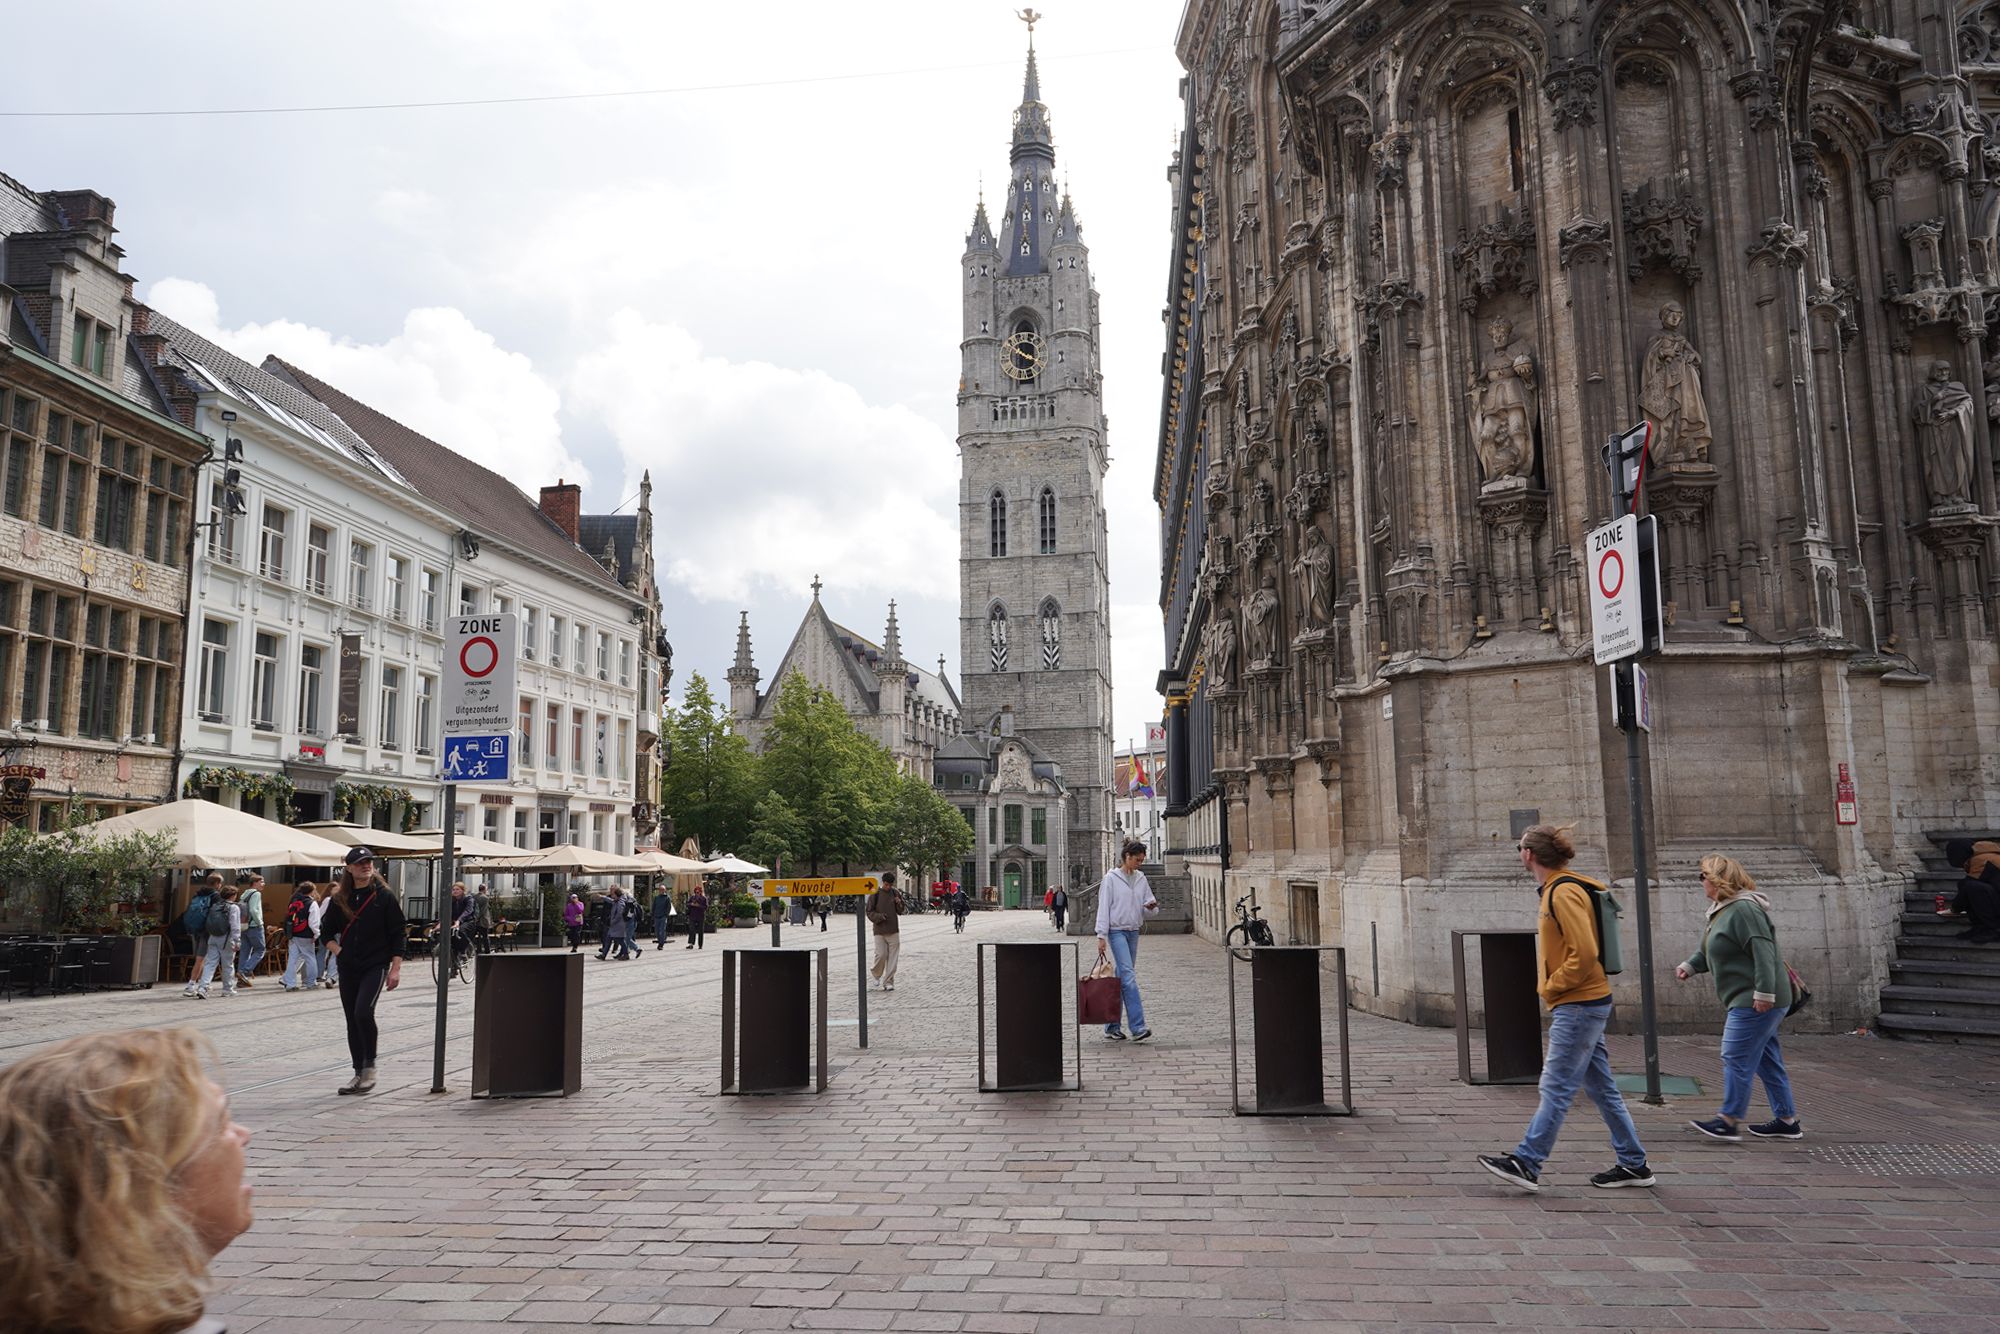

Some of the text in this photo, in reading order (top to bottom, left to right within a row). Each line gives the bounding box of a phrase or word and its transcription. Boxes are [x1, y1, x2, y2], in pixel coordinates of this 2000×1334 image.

[1595, 524, 1623, 552] ZONE
[459, 618, 501, 634] ZONE
[1601, 626, 1629, 644] Uitgezonderd
[456, 704, 499, 715] Uitgezonderd
[446, 716, 508, 728] vergunninghouders
[792, 881, 835, 894] Novotel
